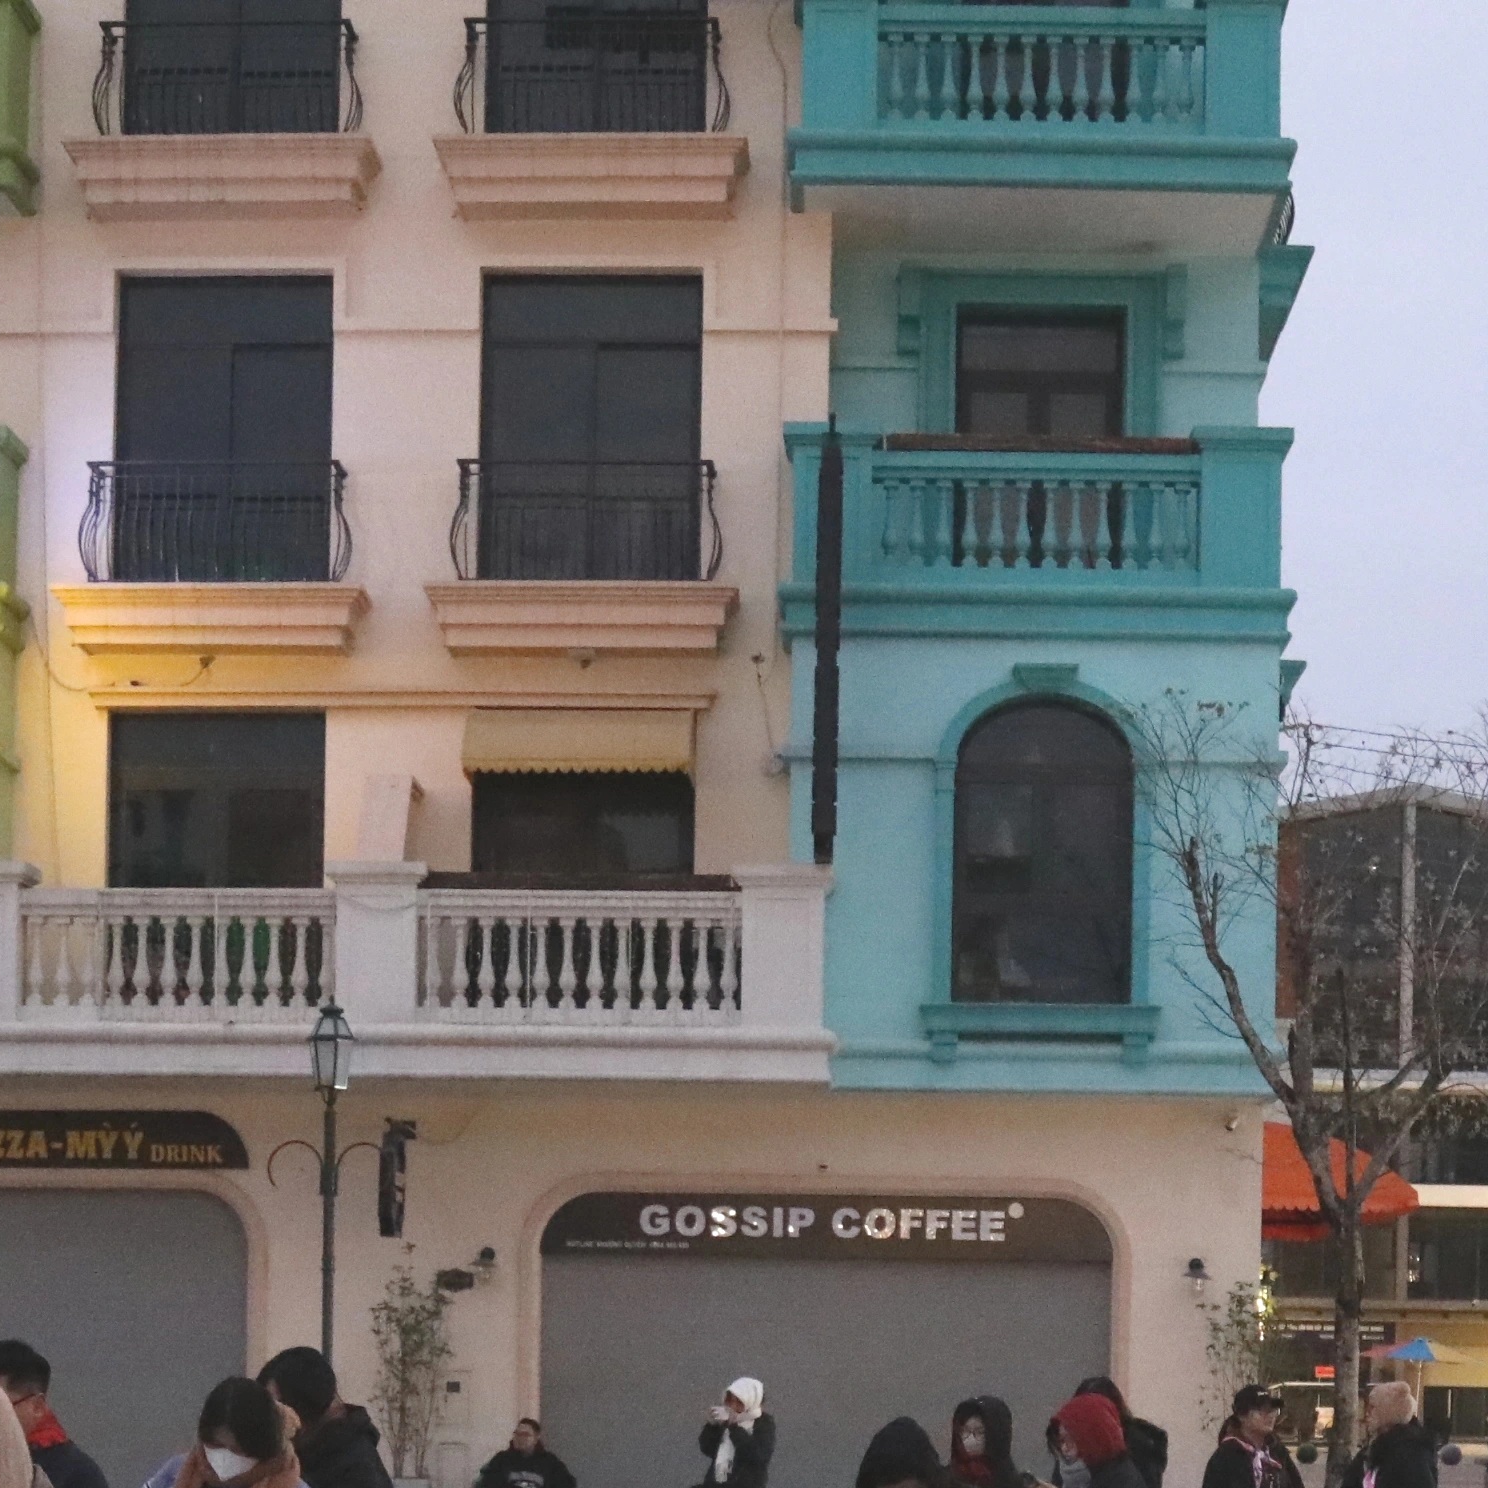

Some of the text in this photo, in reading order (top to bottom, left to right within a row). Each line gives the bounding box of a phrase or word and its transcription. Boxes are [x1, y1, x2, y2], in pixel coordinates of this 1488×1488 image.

[150, 1144, 224, 1163] DRINK
[639, 1204, 1006, 1242] GOSSIP COFFEE
